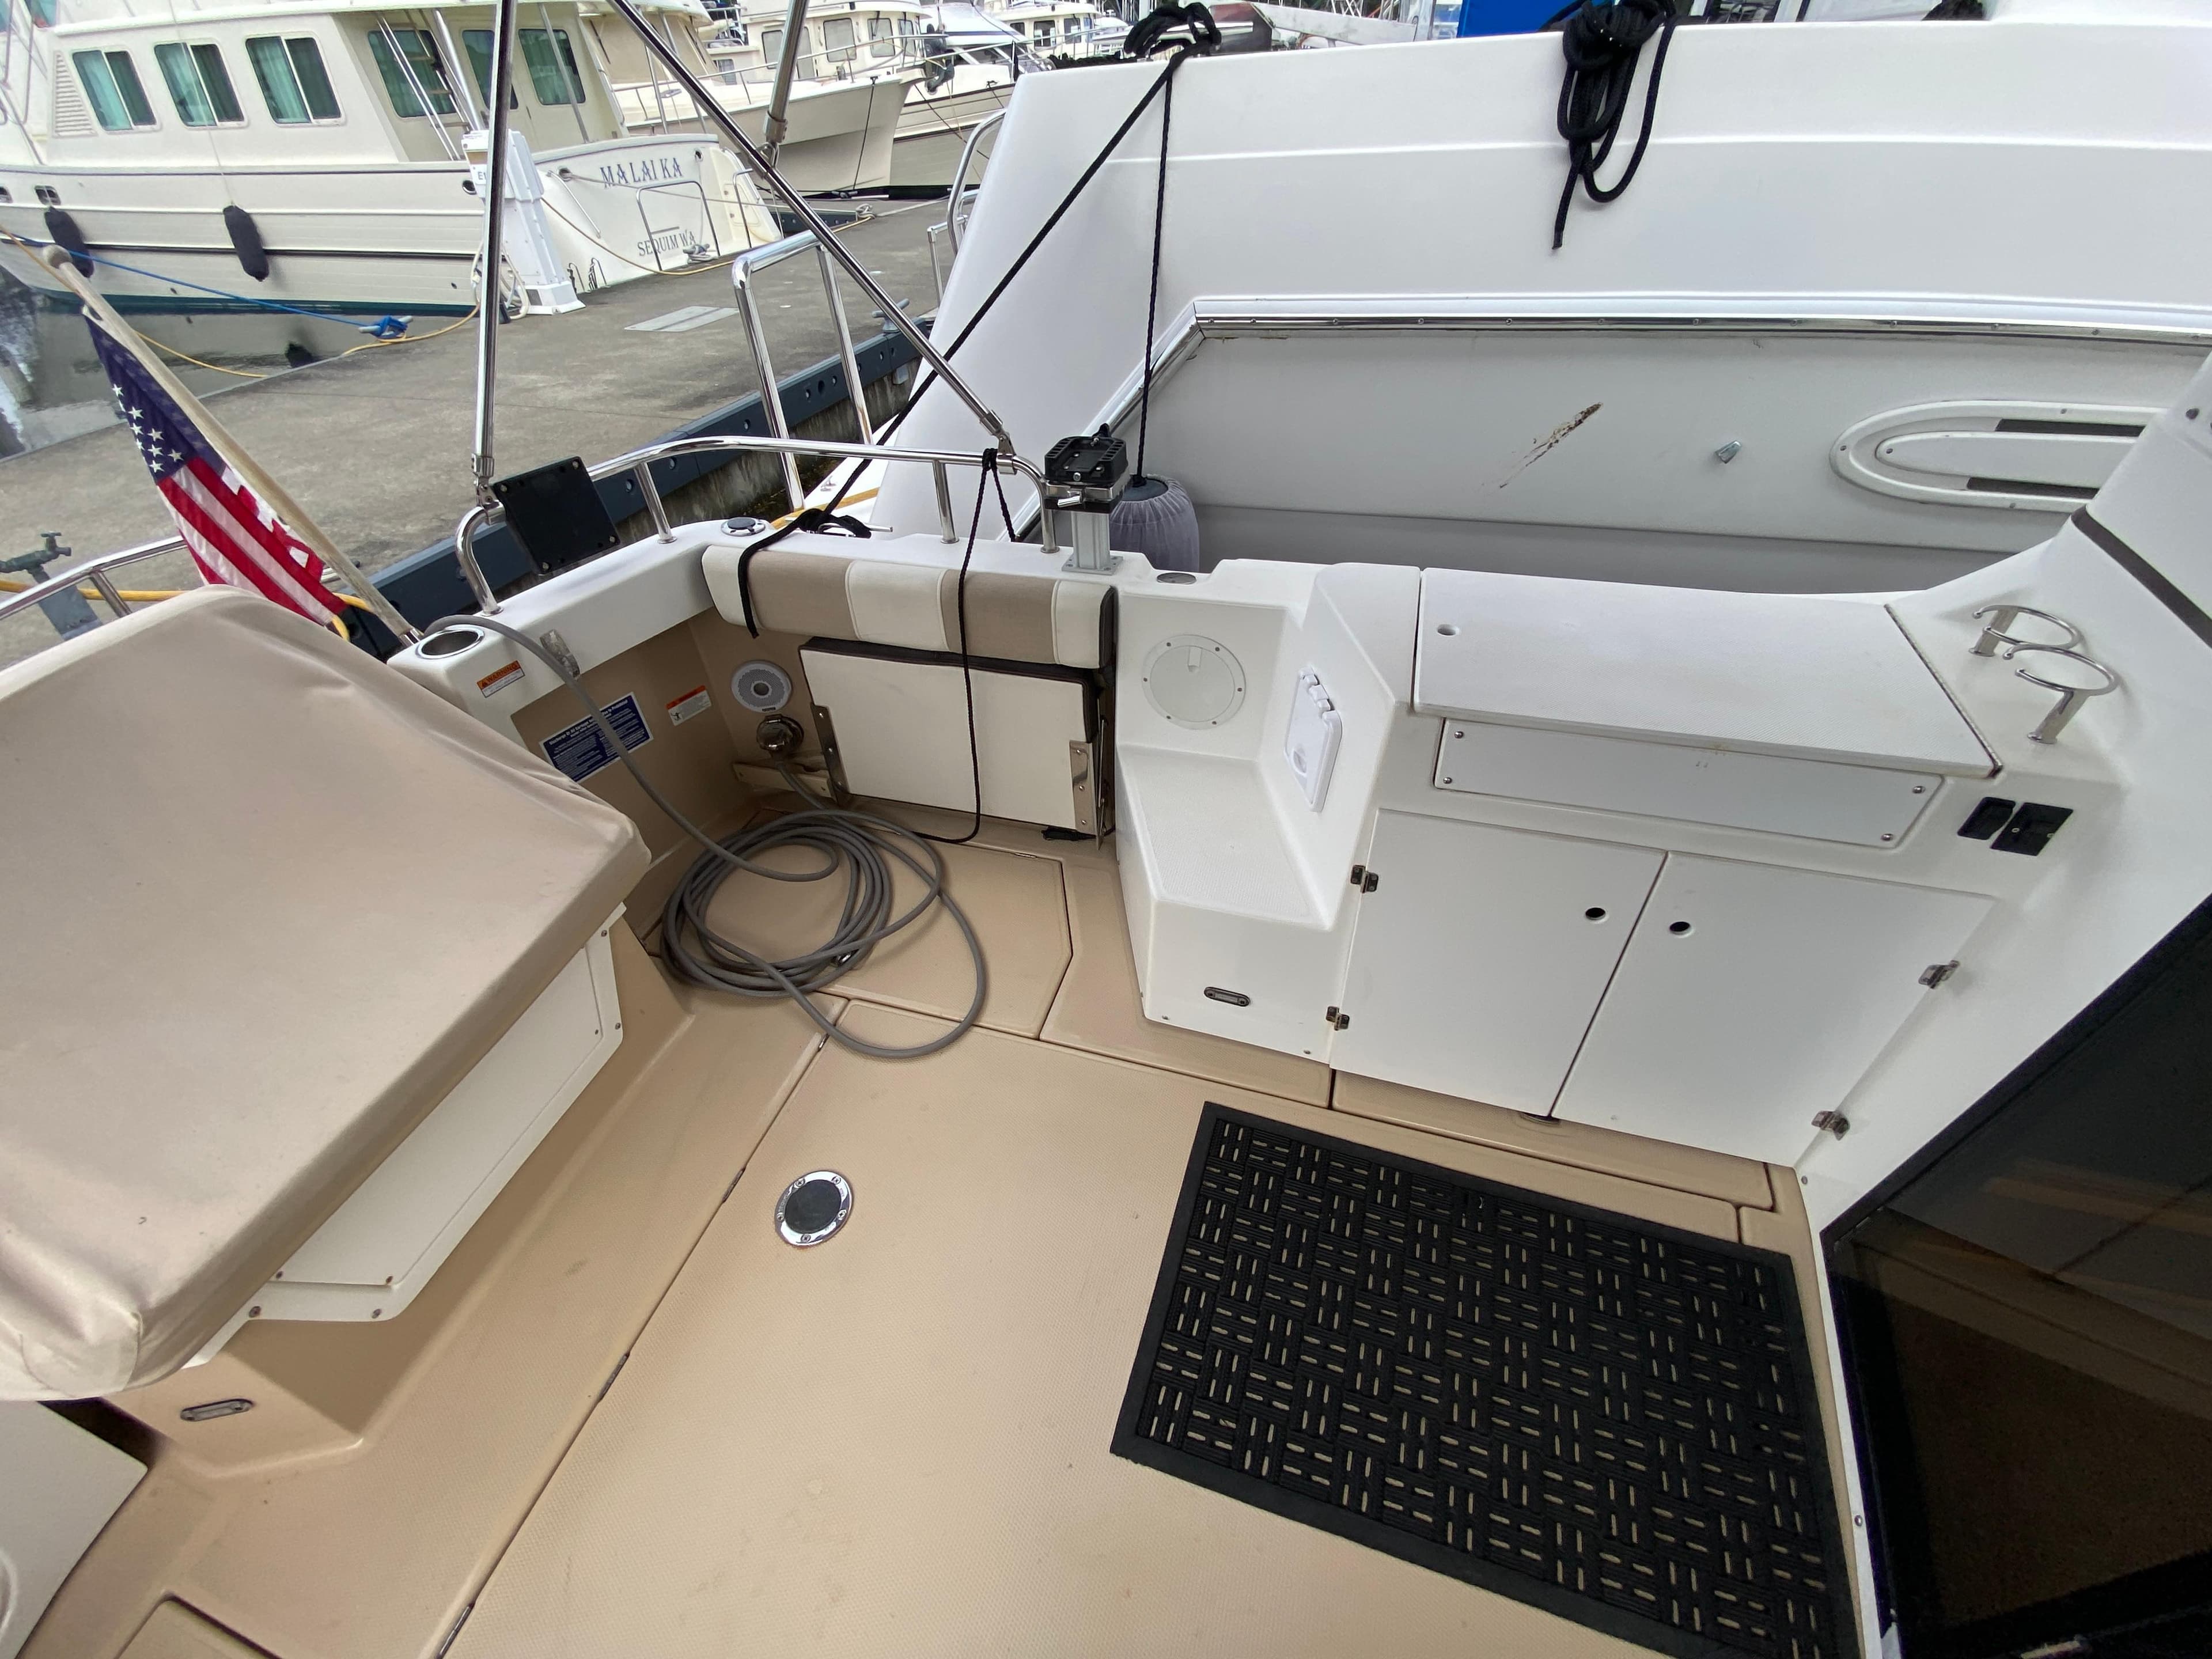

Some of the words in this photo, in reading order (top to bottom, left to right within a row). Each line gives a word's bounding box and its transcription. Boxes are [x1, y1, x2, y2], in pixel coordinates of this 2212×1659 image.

[600, 157, 684, 190] MALAIKA
[637, 234, 679, 256] SEQUIM
[679, 229, 698, 247] WA
[487, 662, 518, 683] WARNING
